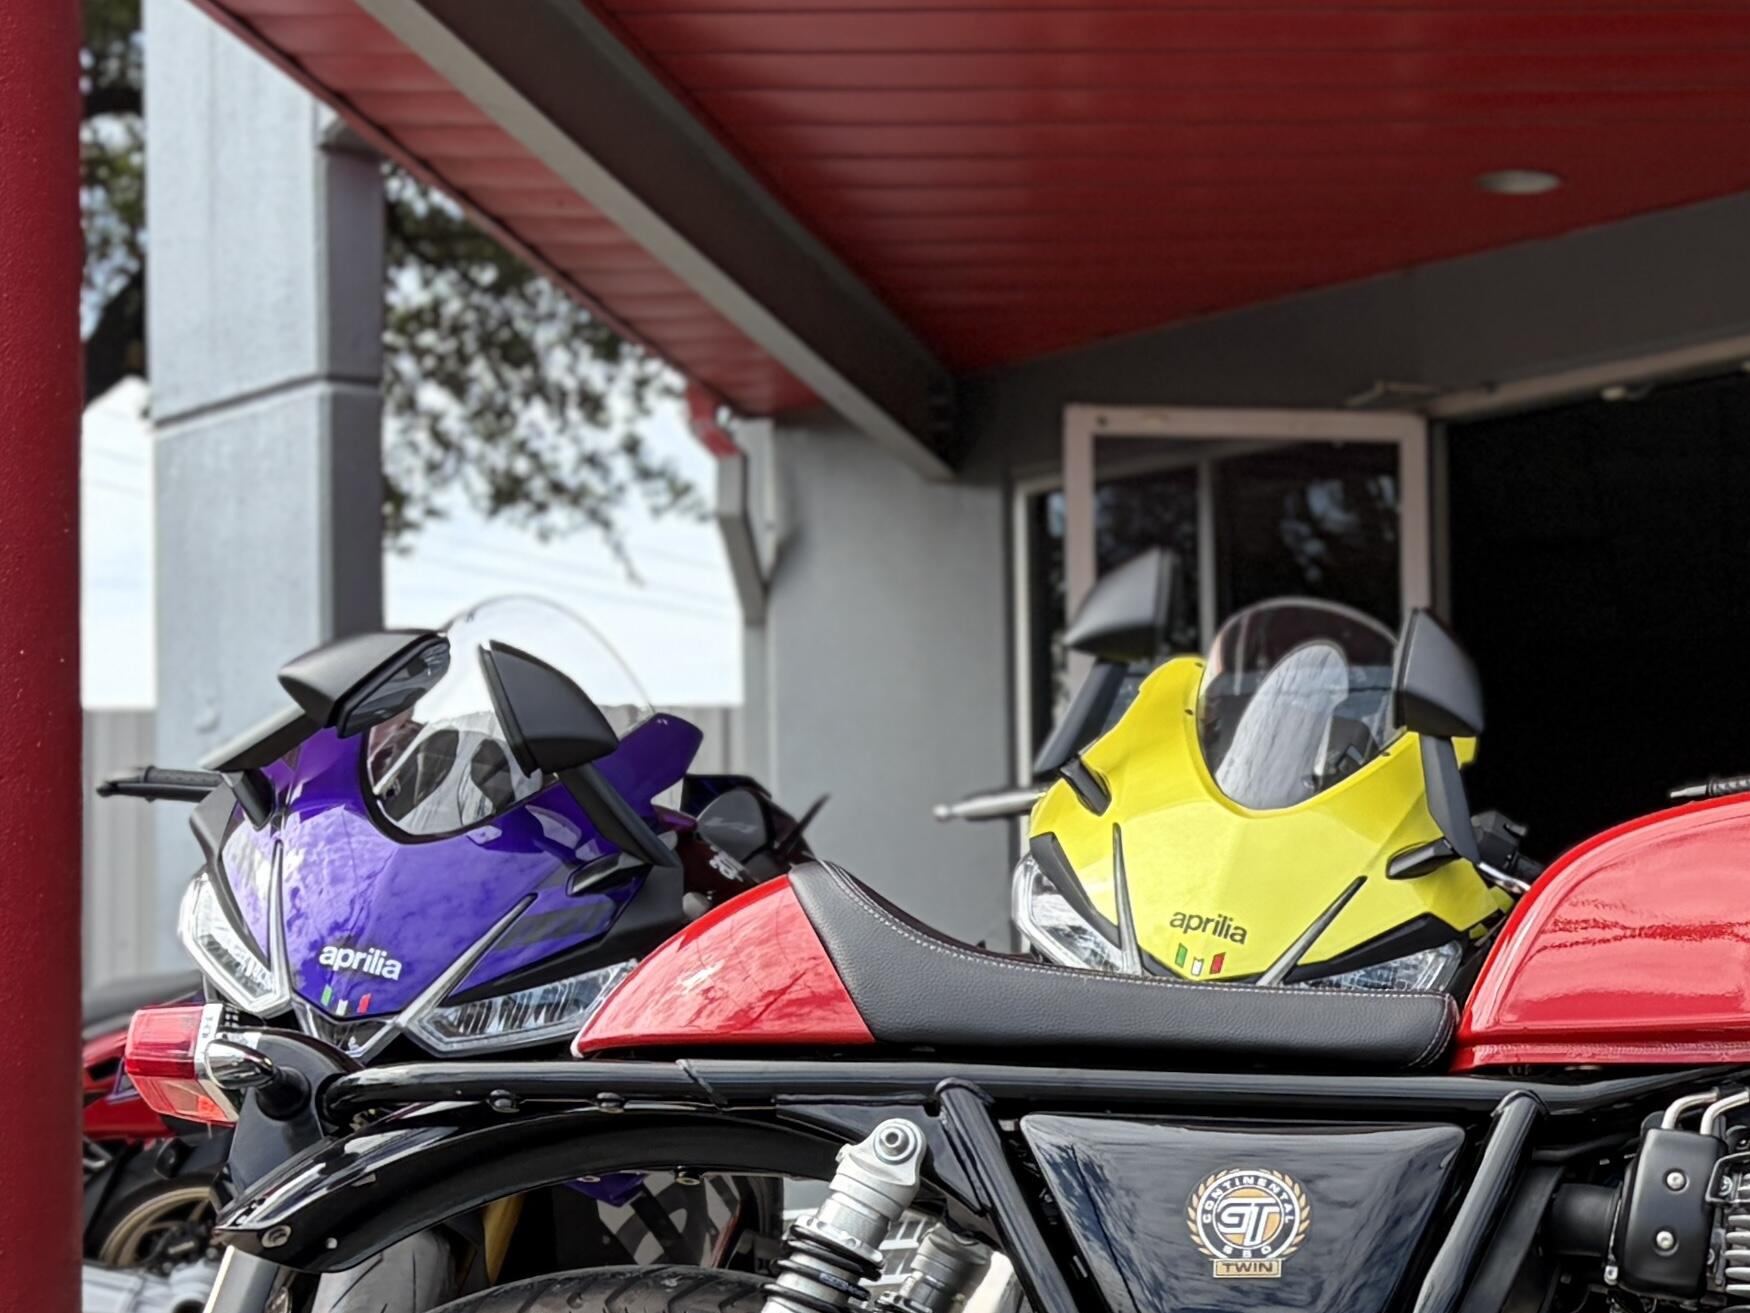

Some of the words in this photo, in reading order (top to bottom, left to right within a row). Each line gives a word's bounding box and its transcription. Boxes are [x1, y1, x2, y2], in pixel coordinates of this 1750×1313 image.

[1169, 911, 1248, 945] aprilia
[318, 945, 403, 981] aprilia
[1202, 1176, 1295, 1224] CONTINENTAL
[1222, 1263, 1274, 1273] TWIN
